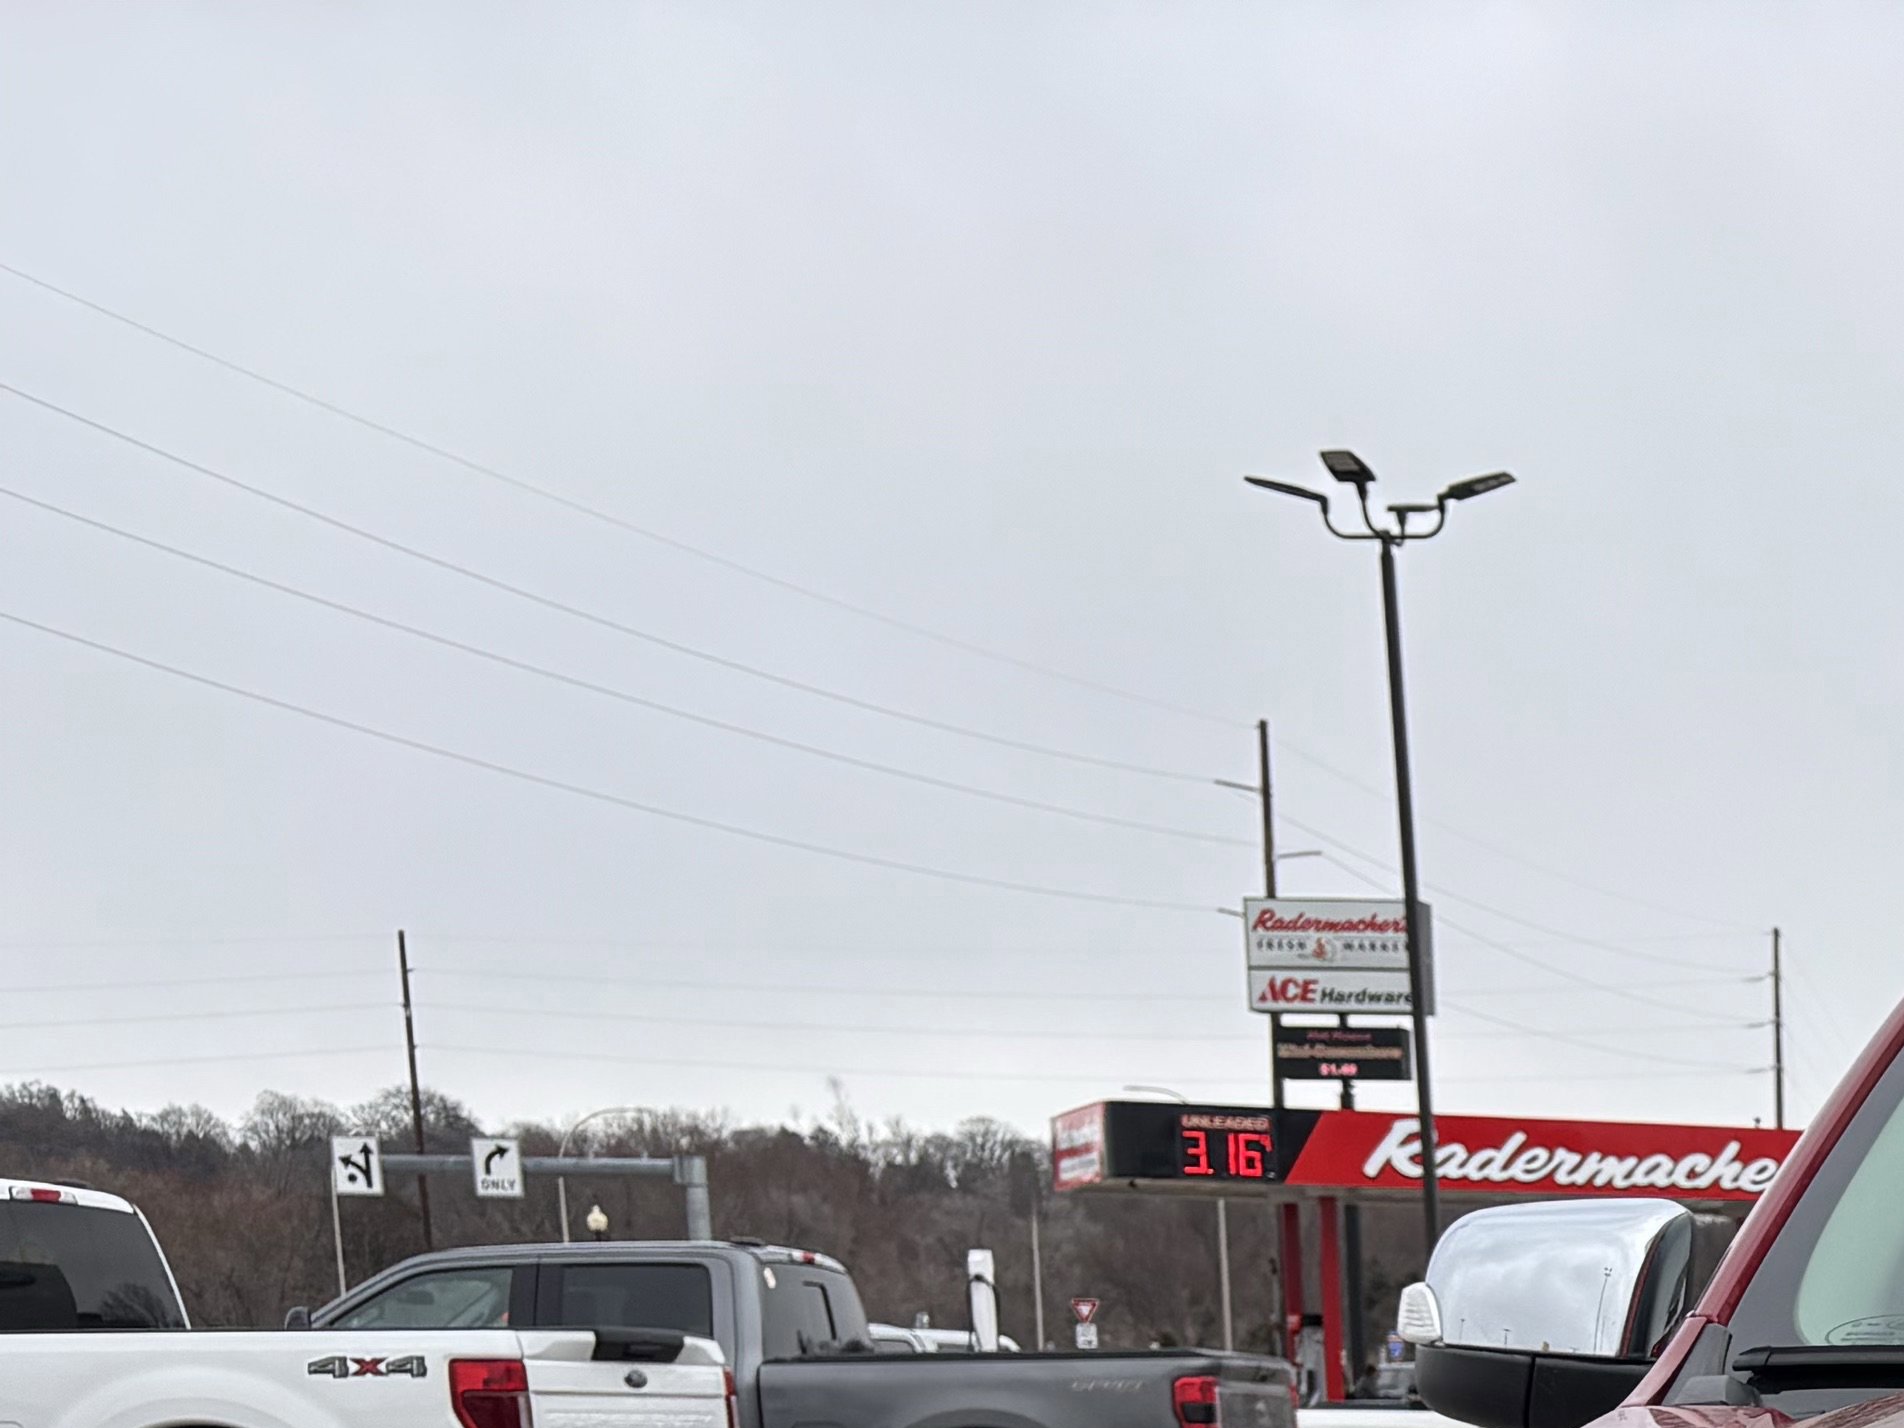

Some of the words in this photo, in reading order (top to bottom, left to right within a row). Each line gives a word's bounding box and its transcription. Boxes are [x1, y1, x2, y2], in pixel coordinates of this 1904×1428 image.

[1252, 909, 1407, 933] Radermacher
[1257, 975, 1319, 1004] ACE
[481, 1178, 515, 1191] ONLY
